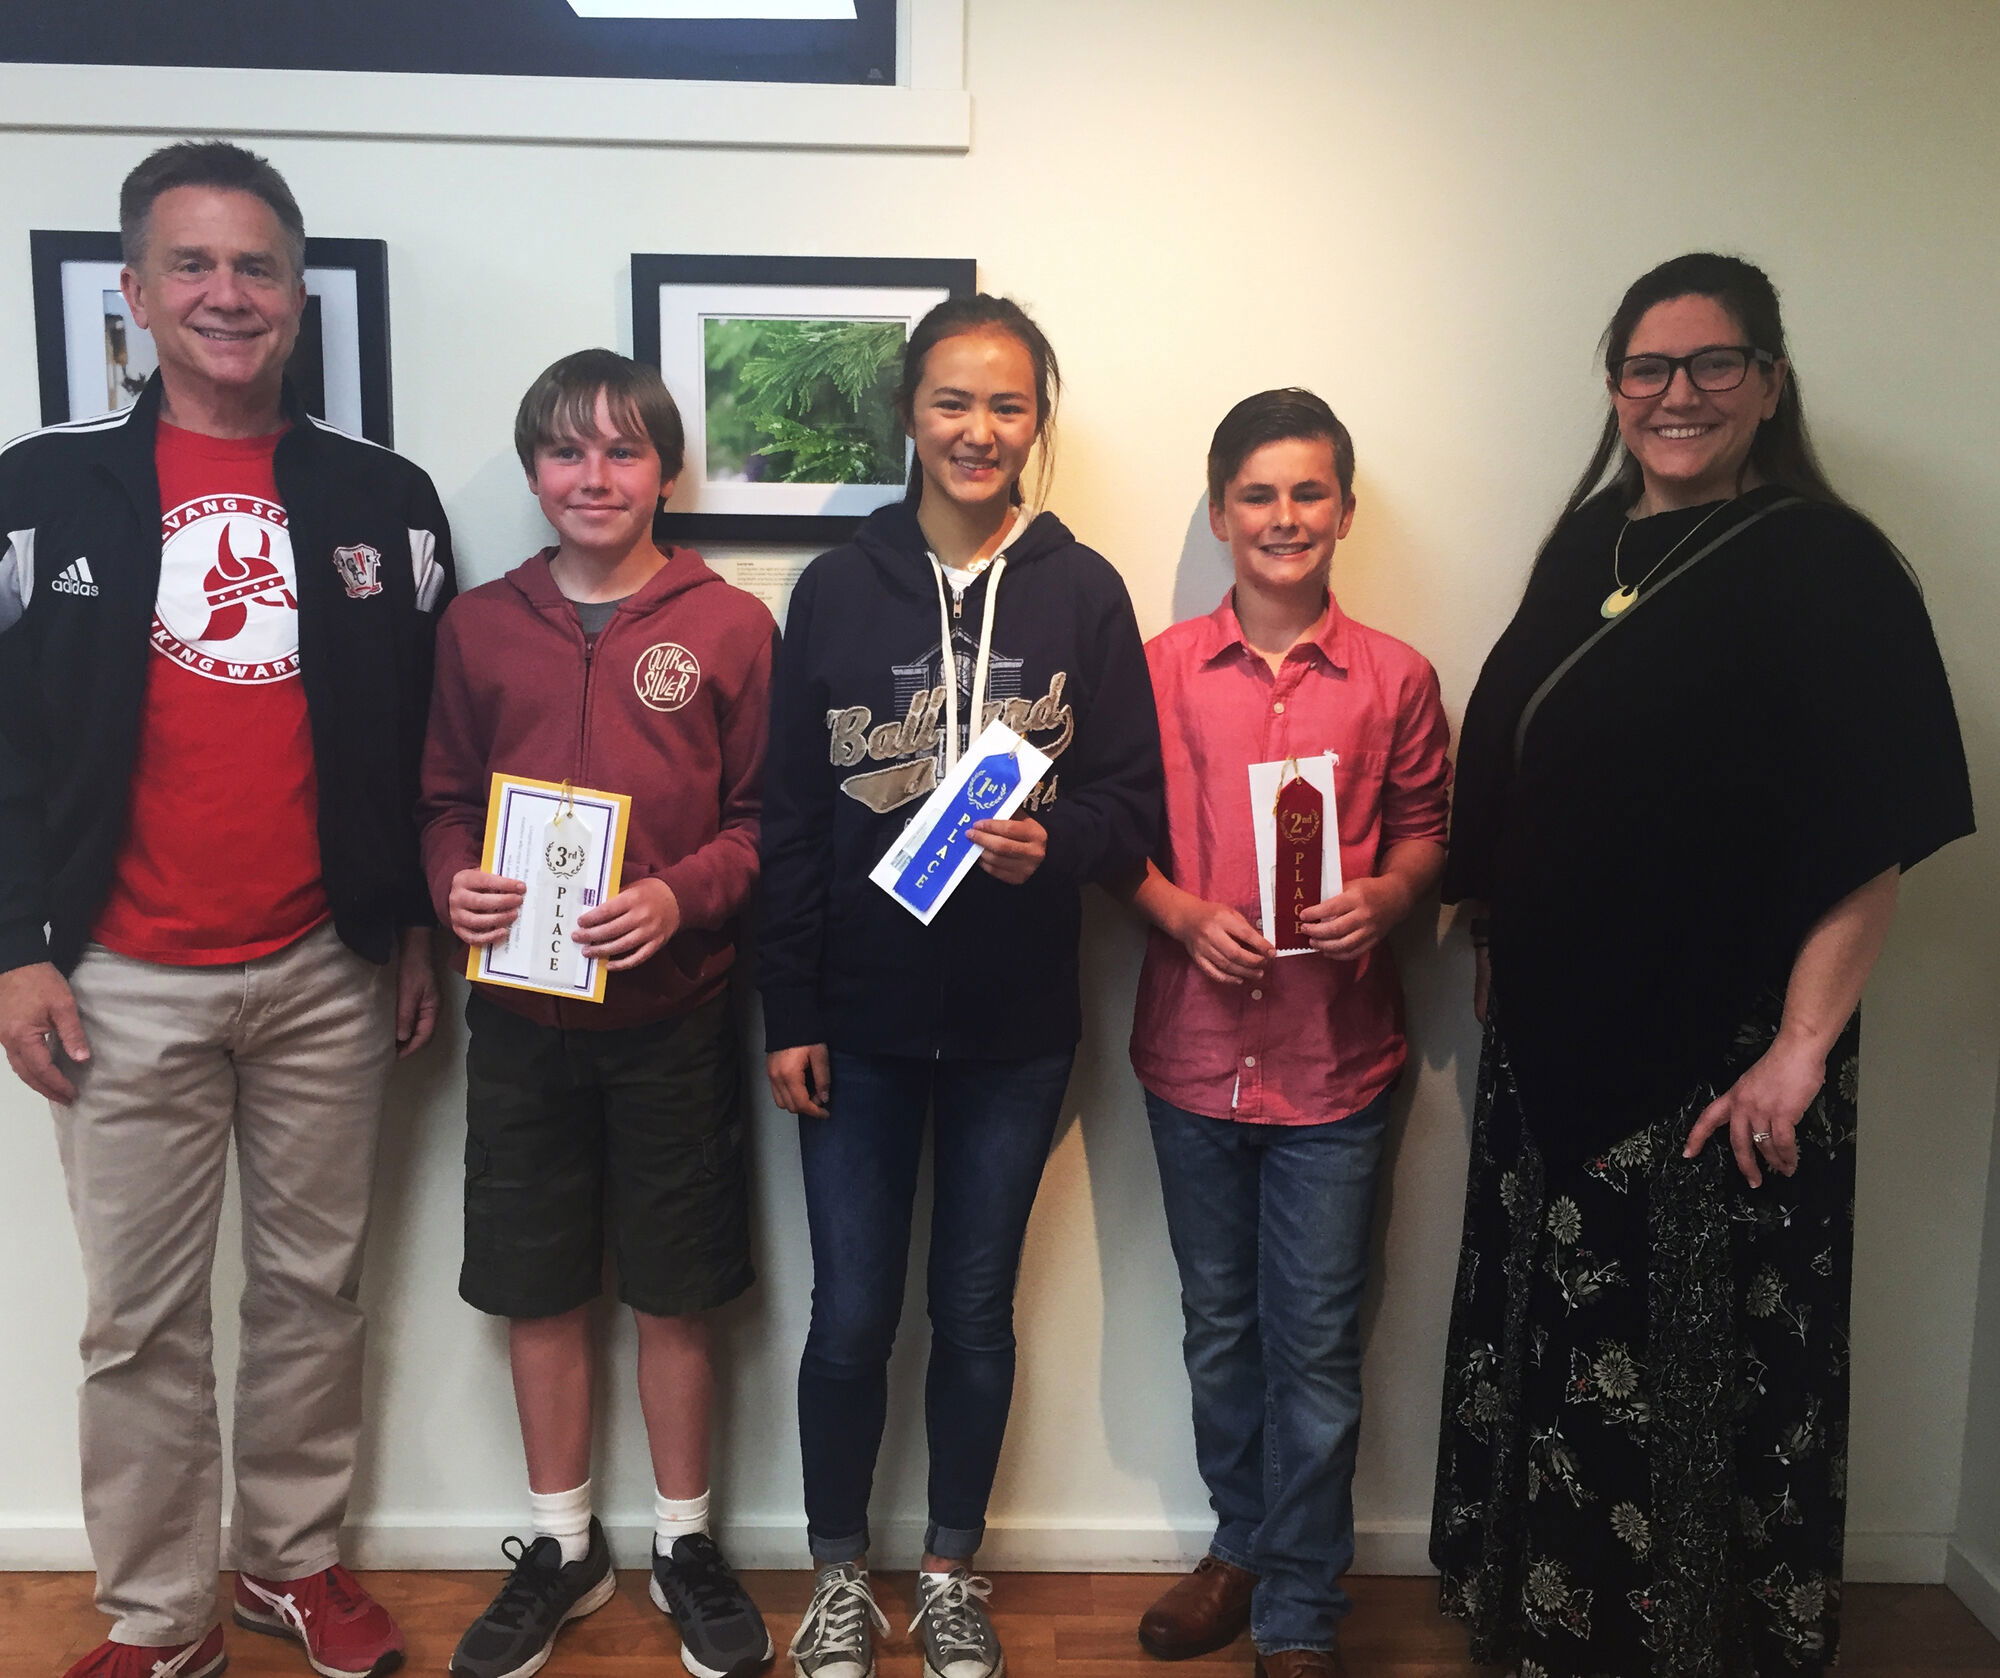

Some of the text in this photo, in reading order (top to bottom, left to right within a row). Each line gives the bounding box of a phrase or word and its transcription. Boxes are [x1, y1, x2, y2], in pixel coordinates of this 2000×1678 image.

[51, 579, 99, 597] adidas
[648, 648, 684, 672] QUIK
[640, 669, 690, 702] SILVER
[975, 777, 999, 798] 1st
[1290, 812, 1312, 834] 2nd
[555, 846, 578, 867] 3rd
[915, 813, 971, 889] PLACE
[550, 886, 567, 971] PLACE
